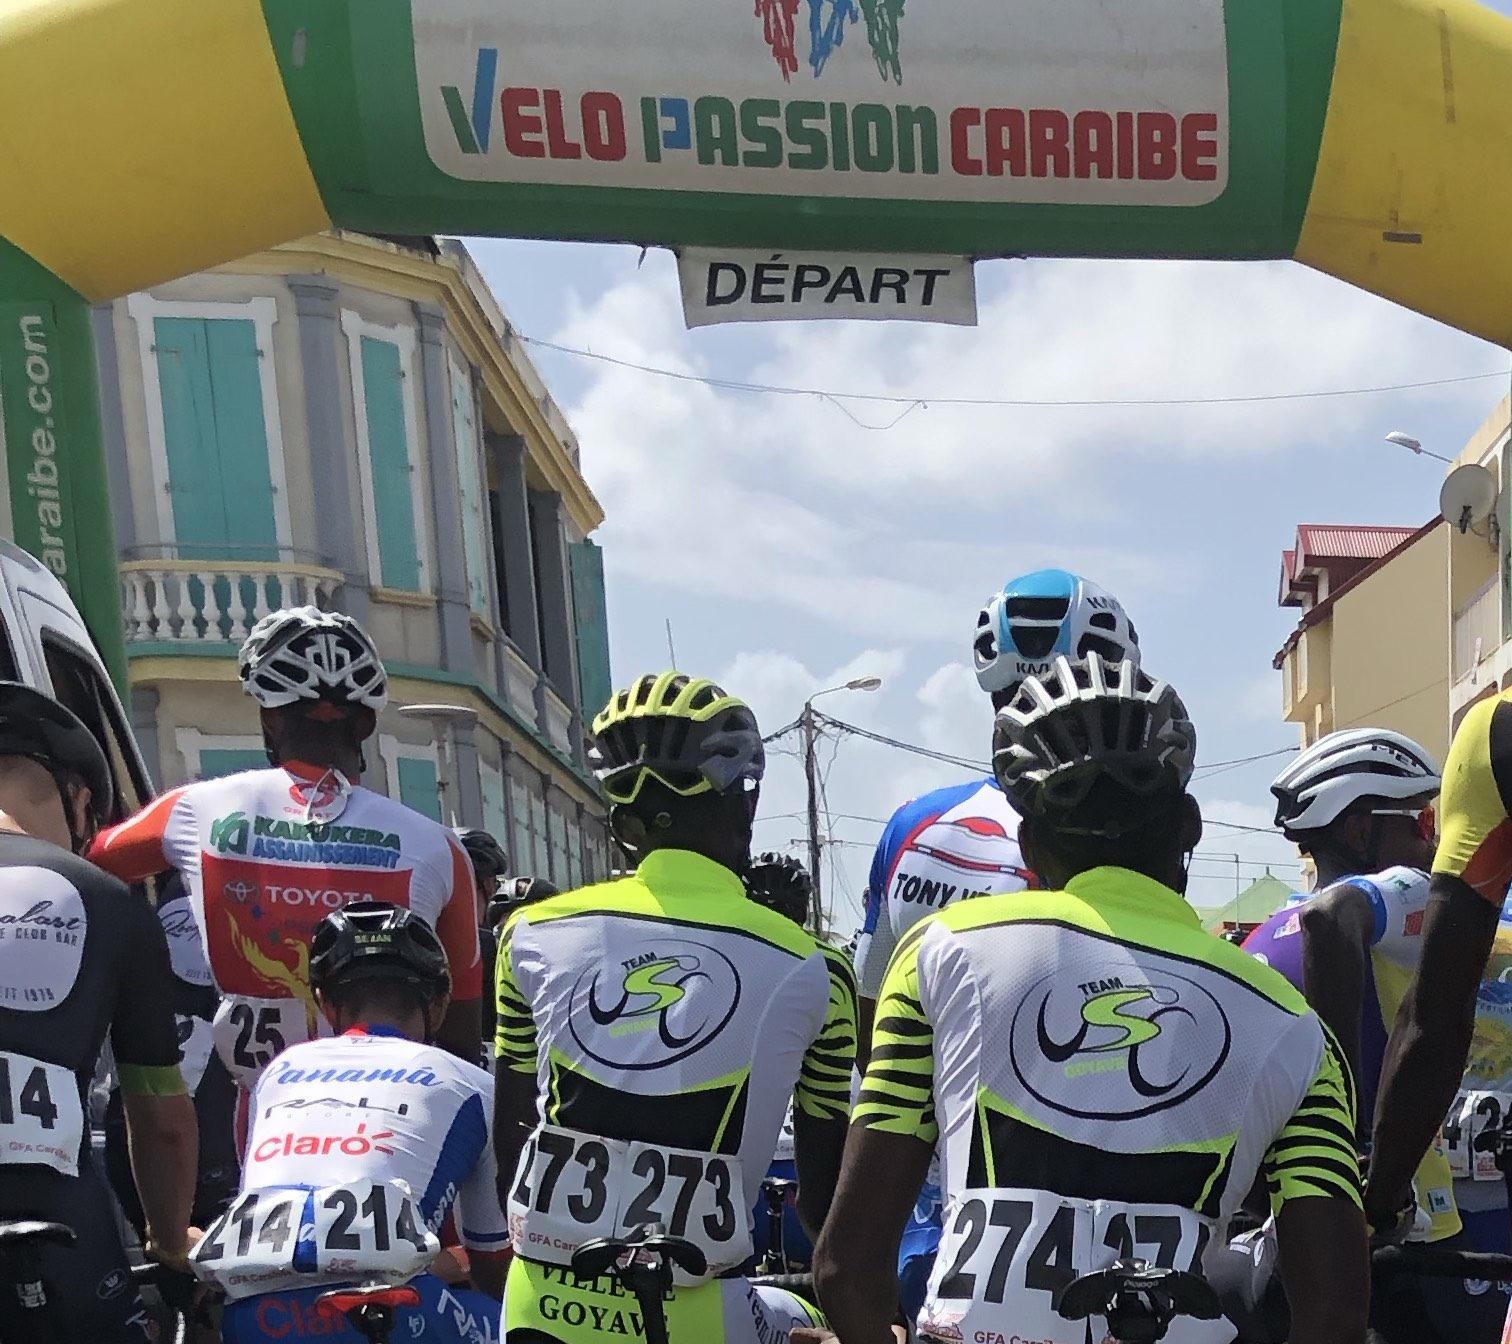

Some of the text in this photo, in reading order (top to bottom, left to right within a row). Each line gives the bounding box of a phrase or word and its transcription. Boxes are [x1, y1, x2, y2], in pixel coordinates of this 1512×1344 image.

[441, 48, 1219, 182] VELO PASSION CARAIBE
[706, 254, 951, 308] DÉPART
[19, 315, 68, 590] araibe.com
[893, 873, 957, 908] TONY
[620, 951, 658, 971] TEAM
[1077, 976, 1124, 996] TEAM
[256, 1061, 443, 1095] Panamá
[323, 1184, 429, 1253] 214
[622, 1149, 736, 1243] 273
[529, 1232, 551, 1247] GFA
[937, 1198, 1081, 1312] 274
[1103, 1212, 1208, 1276] 27
[538, 1294, 671, 1342] GOYAV
